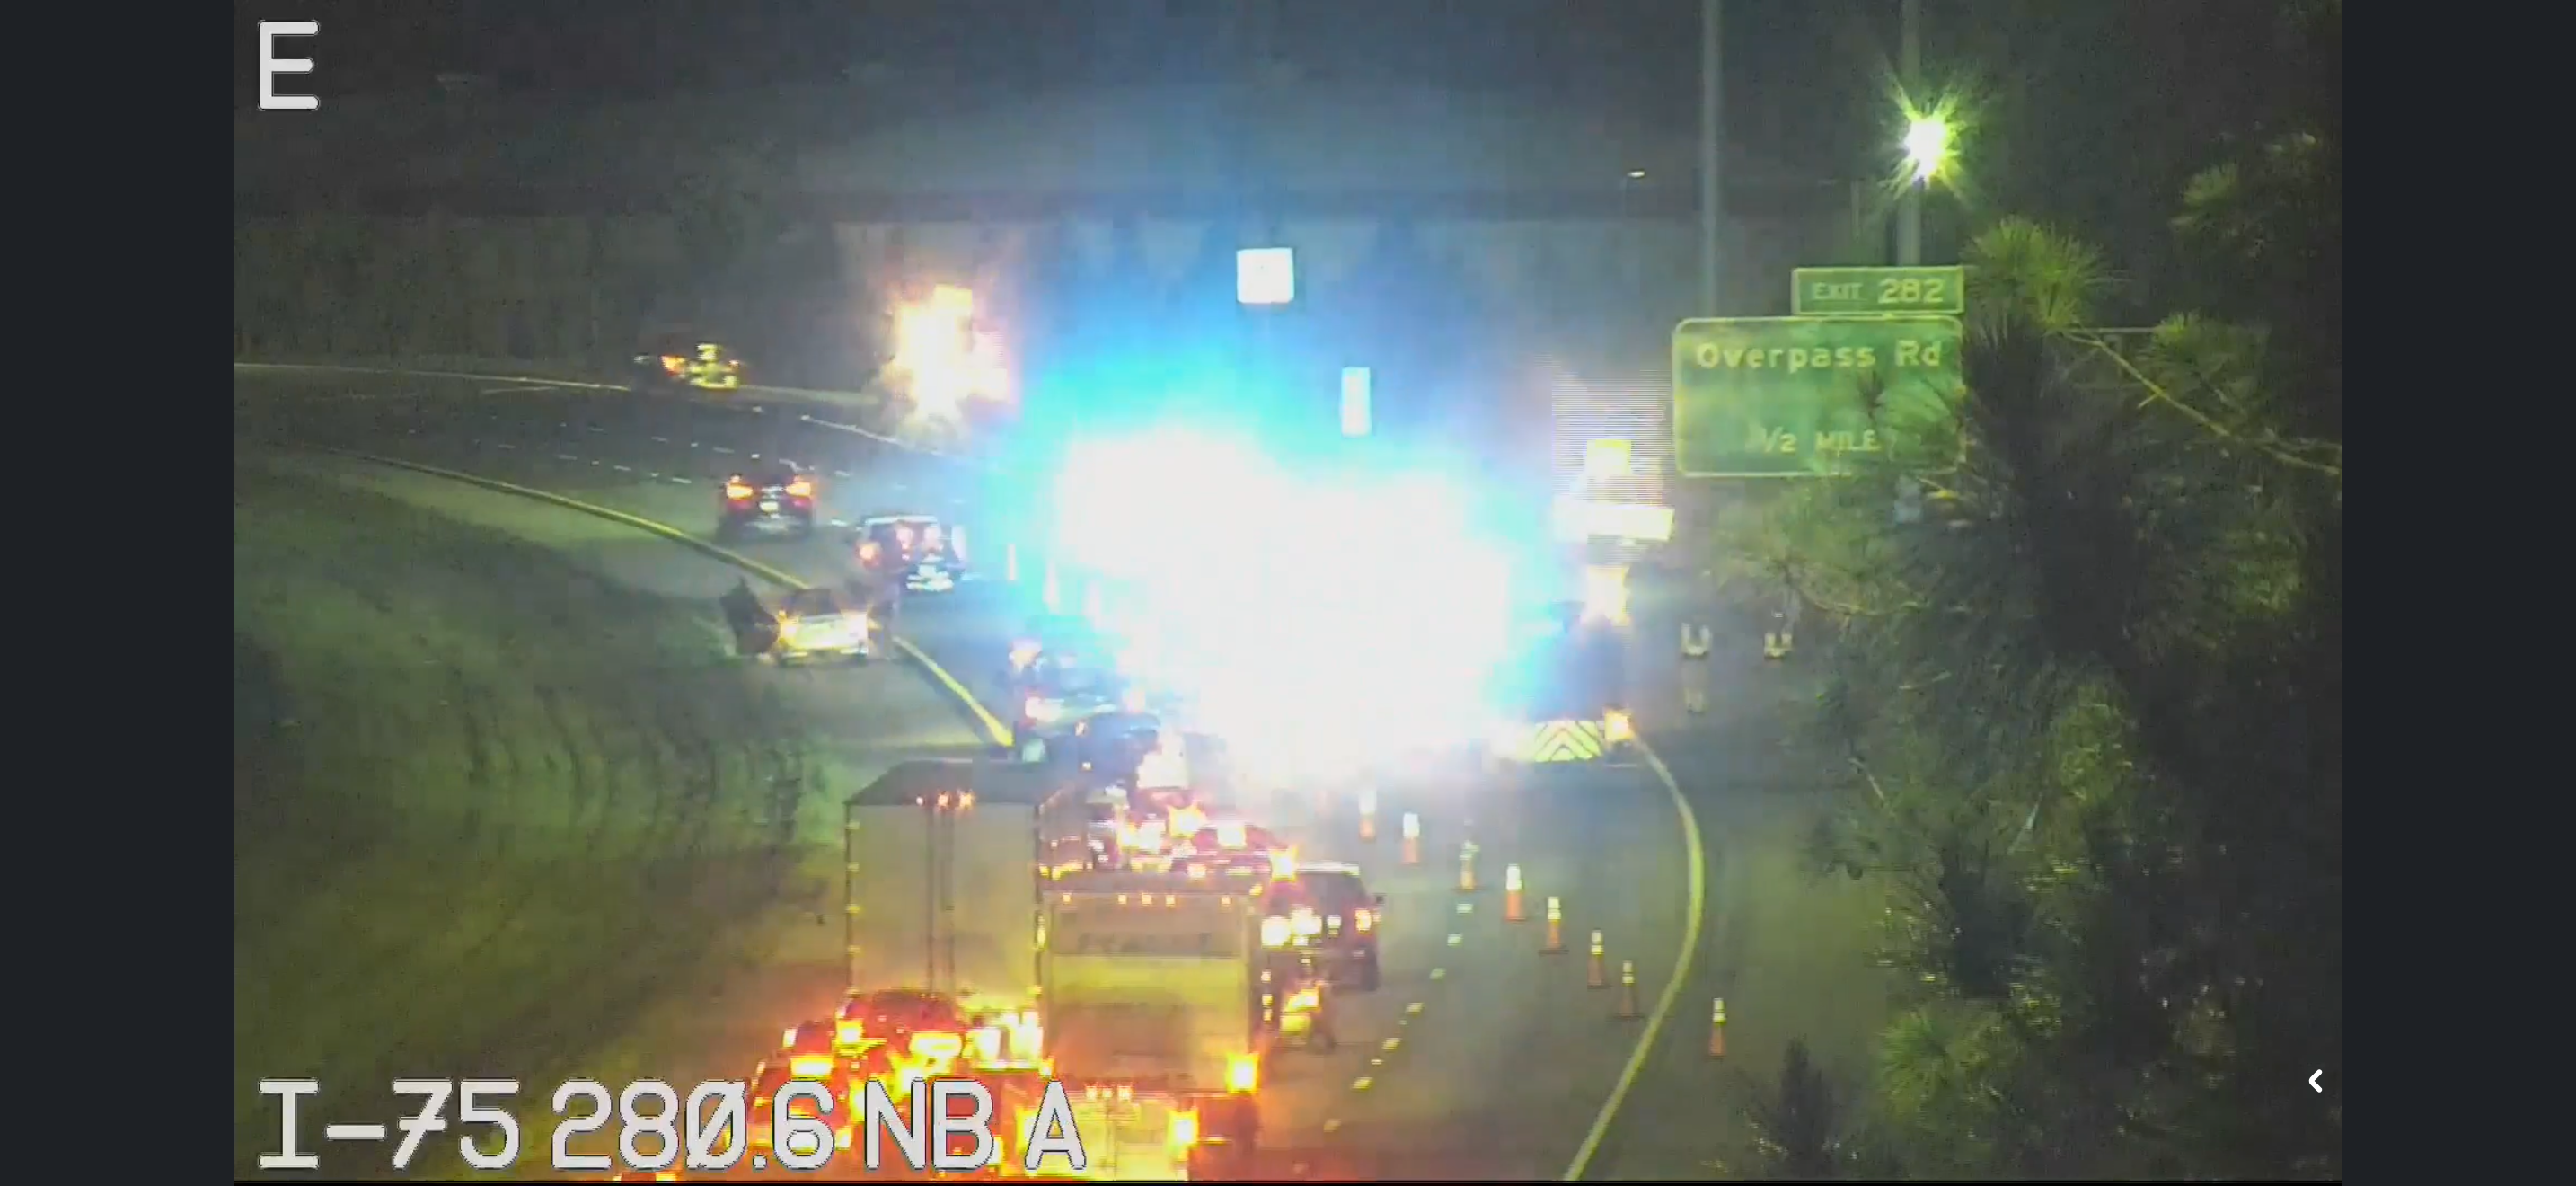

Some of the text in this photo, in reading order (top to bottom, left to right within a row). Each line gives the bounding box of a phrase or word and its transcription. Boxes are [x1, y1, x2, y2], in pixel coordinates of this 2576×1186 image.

[1812, 277, 1945, 304] EXIT 282
[1695, 339, 1943, 373] Overpass Rd
